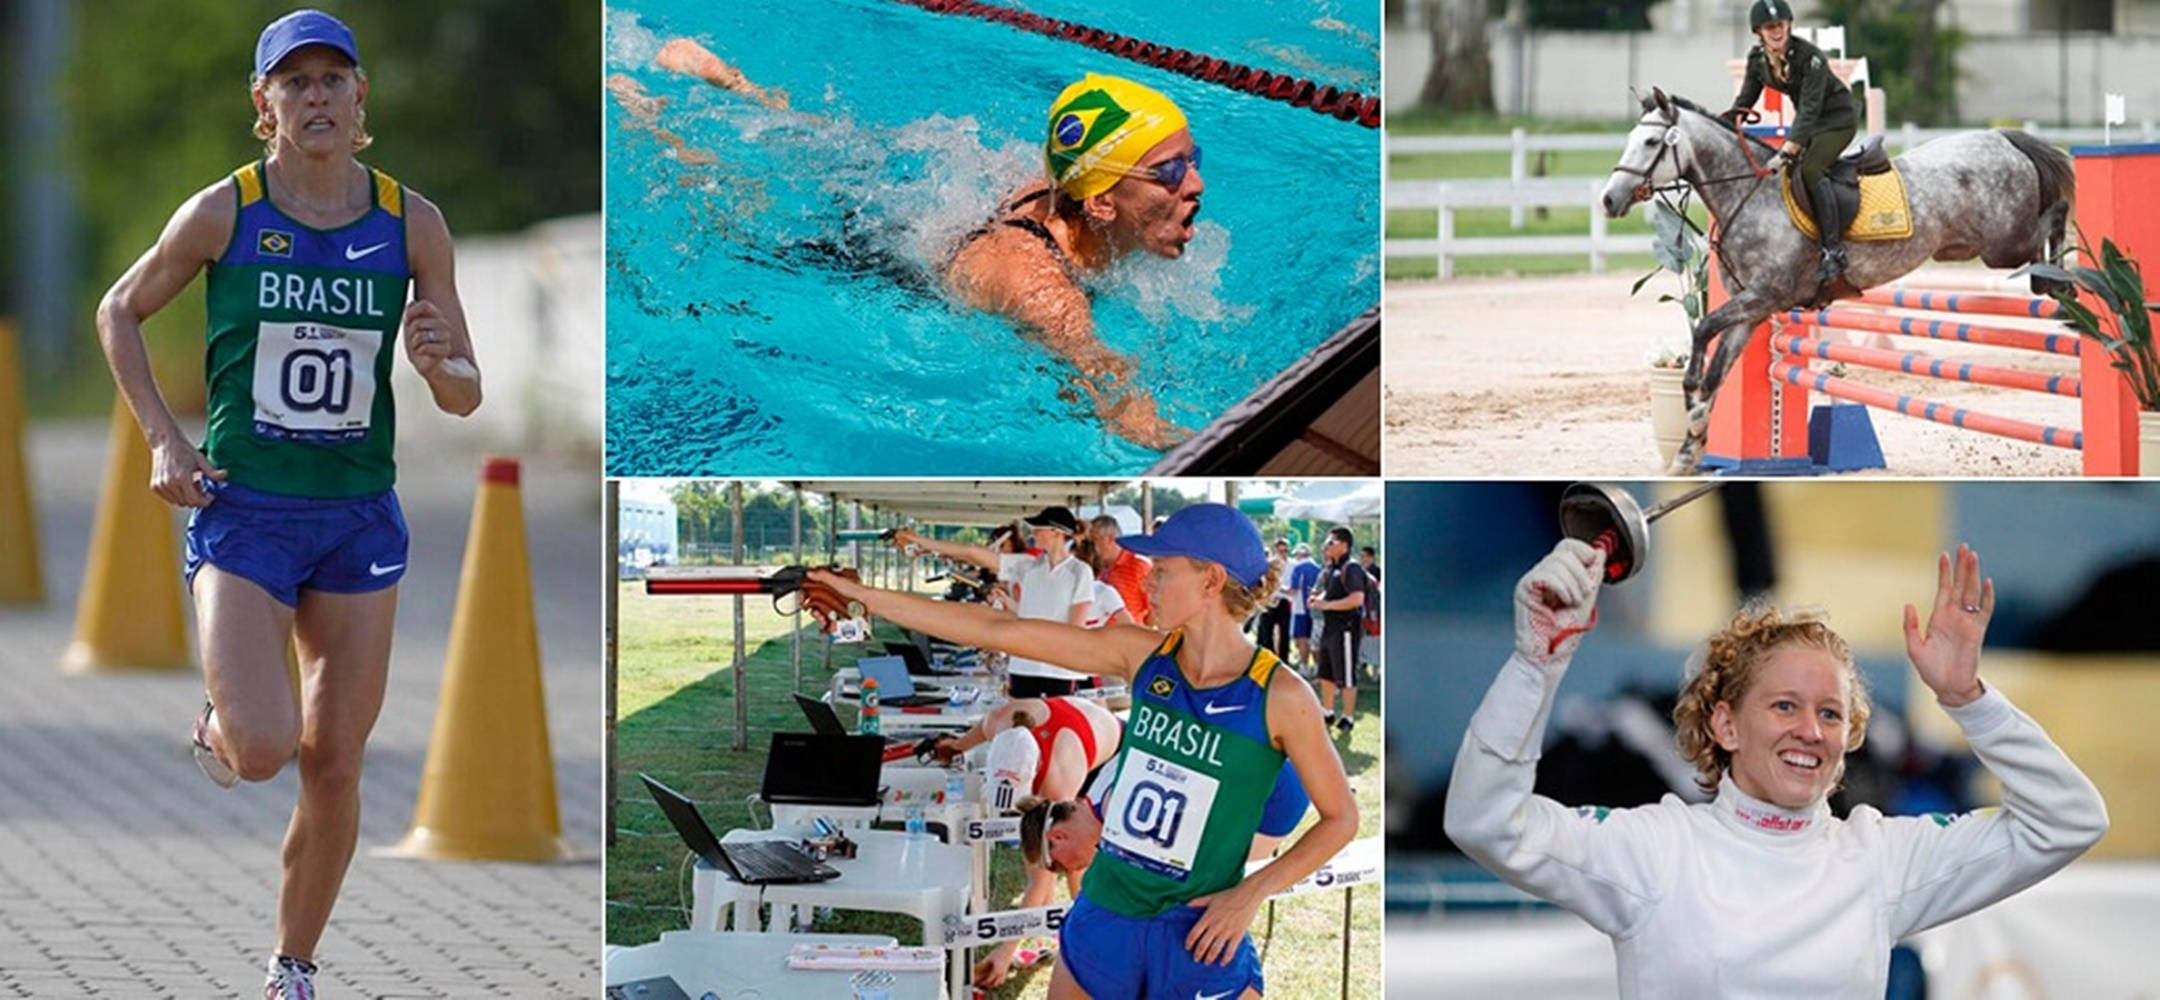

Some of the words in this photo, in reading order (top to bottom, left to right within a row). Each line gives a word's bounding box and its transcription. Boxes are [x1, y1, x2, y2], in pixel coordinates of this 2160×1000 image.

[259, 271, 383, 315] BRASIL
[281, 349, 353, 414] 01
[1134, 706, 1223, 766] BRASIL
[969, 822, 983, 838] 5
[1123, 780, 1188, 849] 01
[977, 918, 997, 939] 5
[1046, 908, 1064, 930] 5
